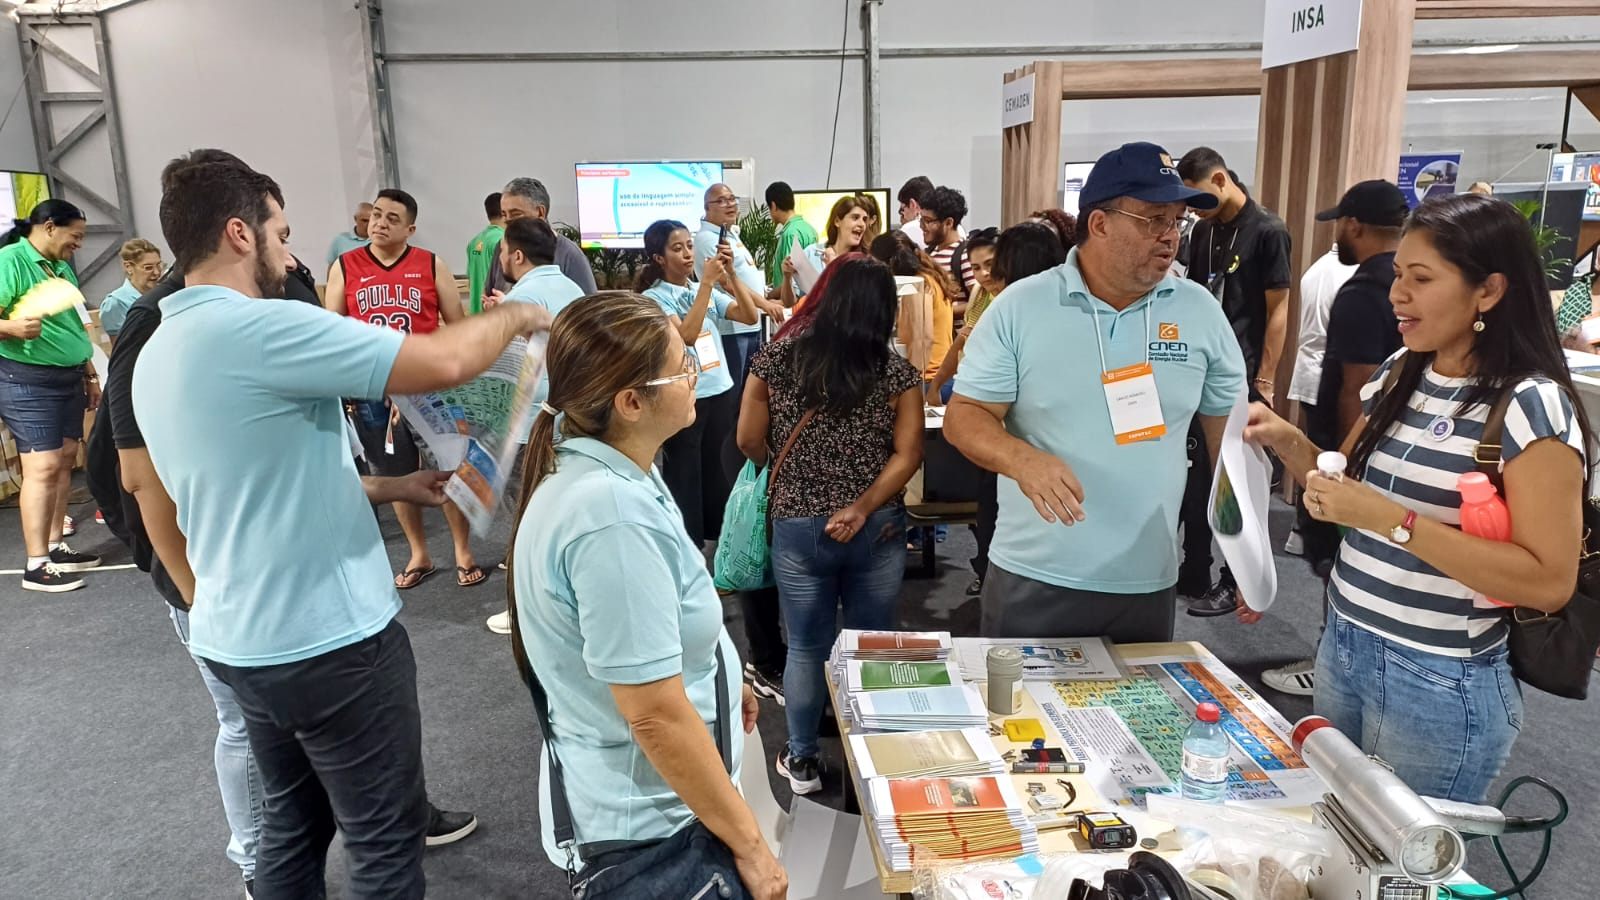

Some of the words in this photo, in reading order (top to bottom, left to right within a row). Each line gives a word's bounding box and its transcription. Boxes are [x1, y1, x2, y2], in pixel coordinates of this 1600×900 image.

[1291, 4, 1325, 33] INSA
[1005, 92, 1030, 112] CEMADEN
[356, 284, 421, 316] BULLS
[1149, 341, 1188, 352] CNEN
